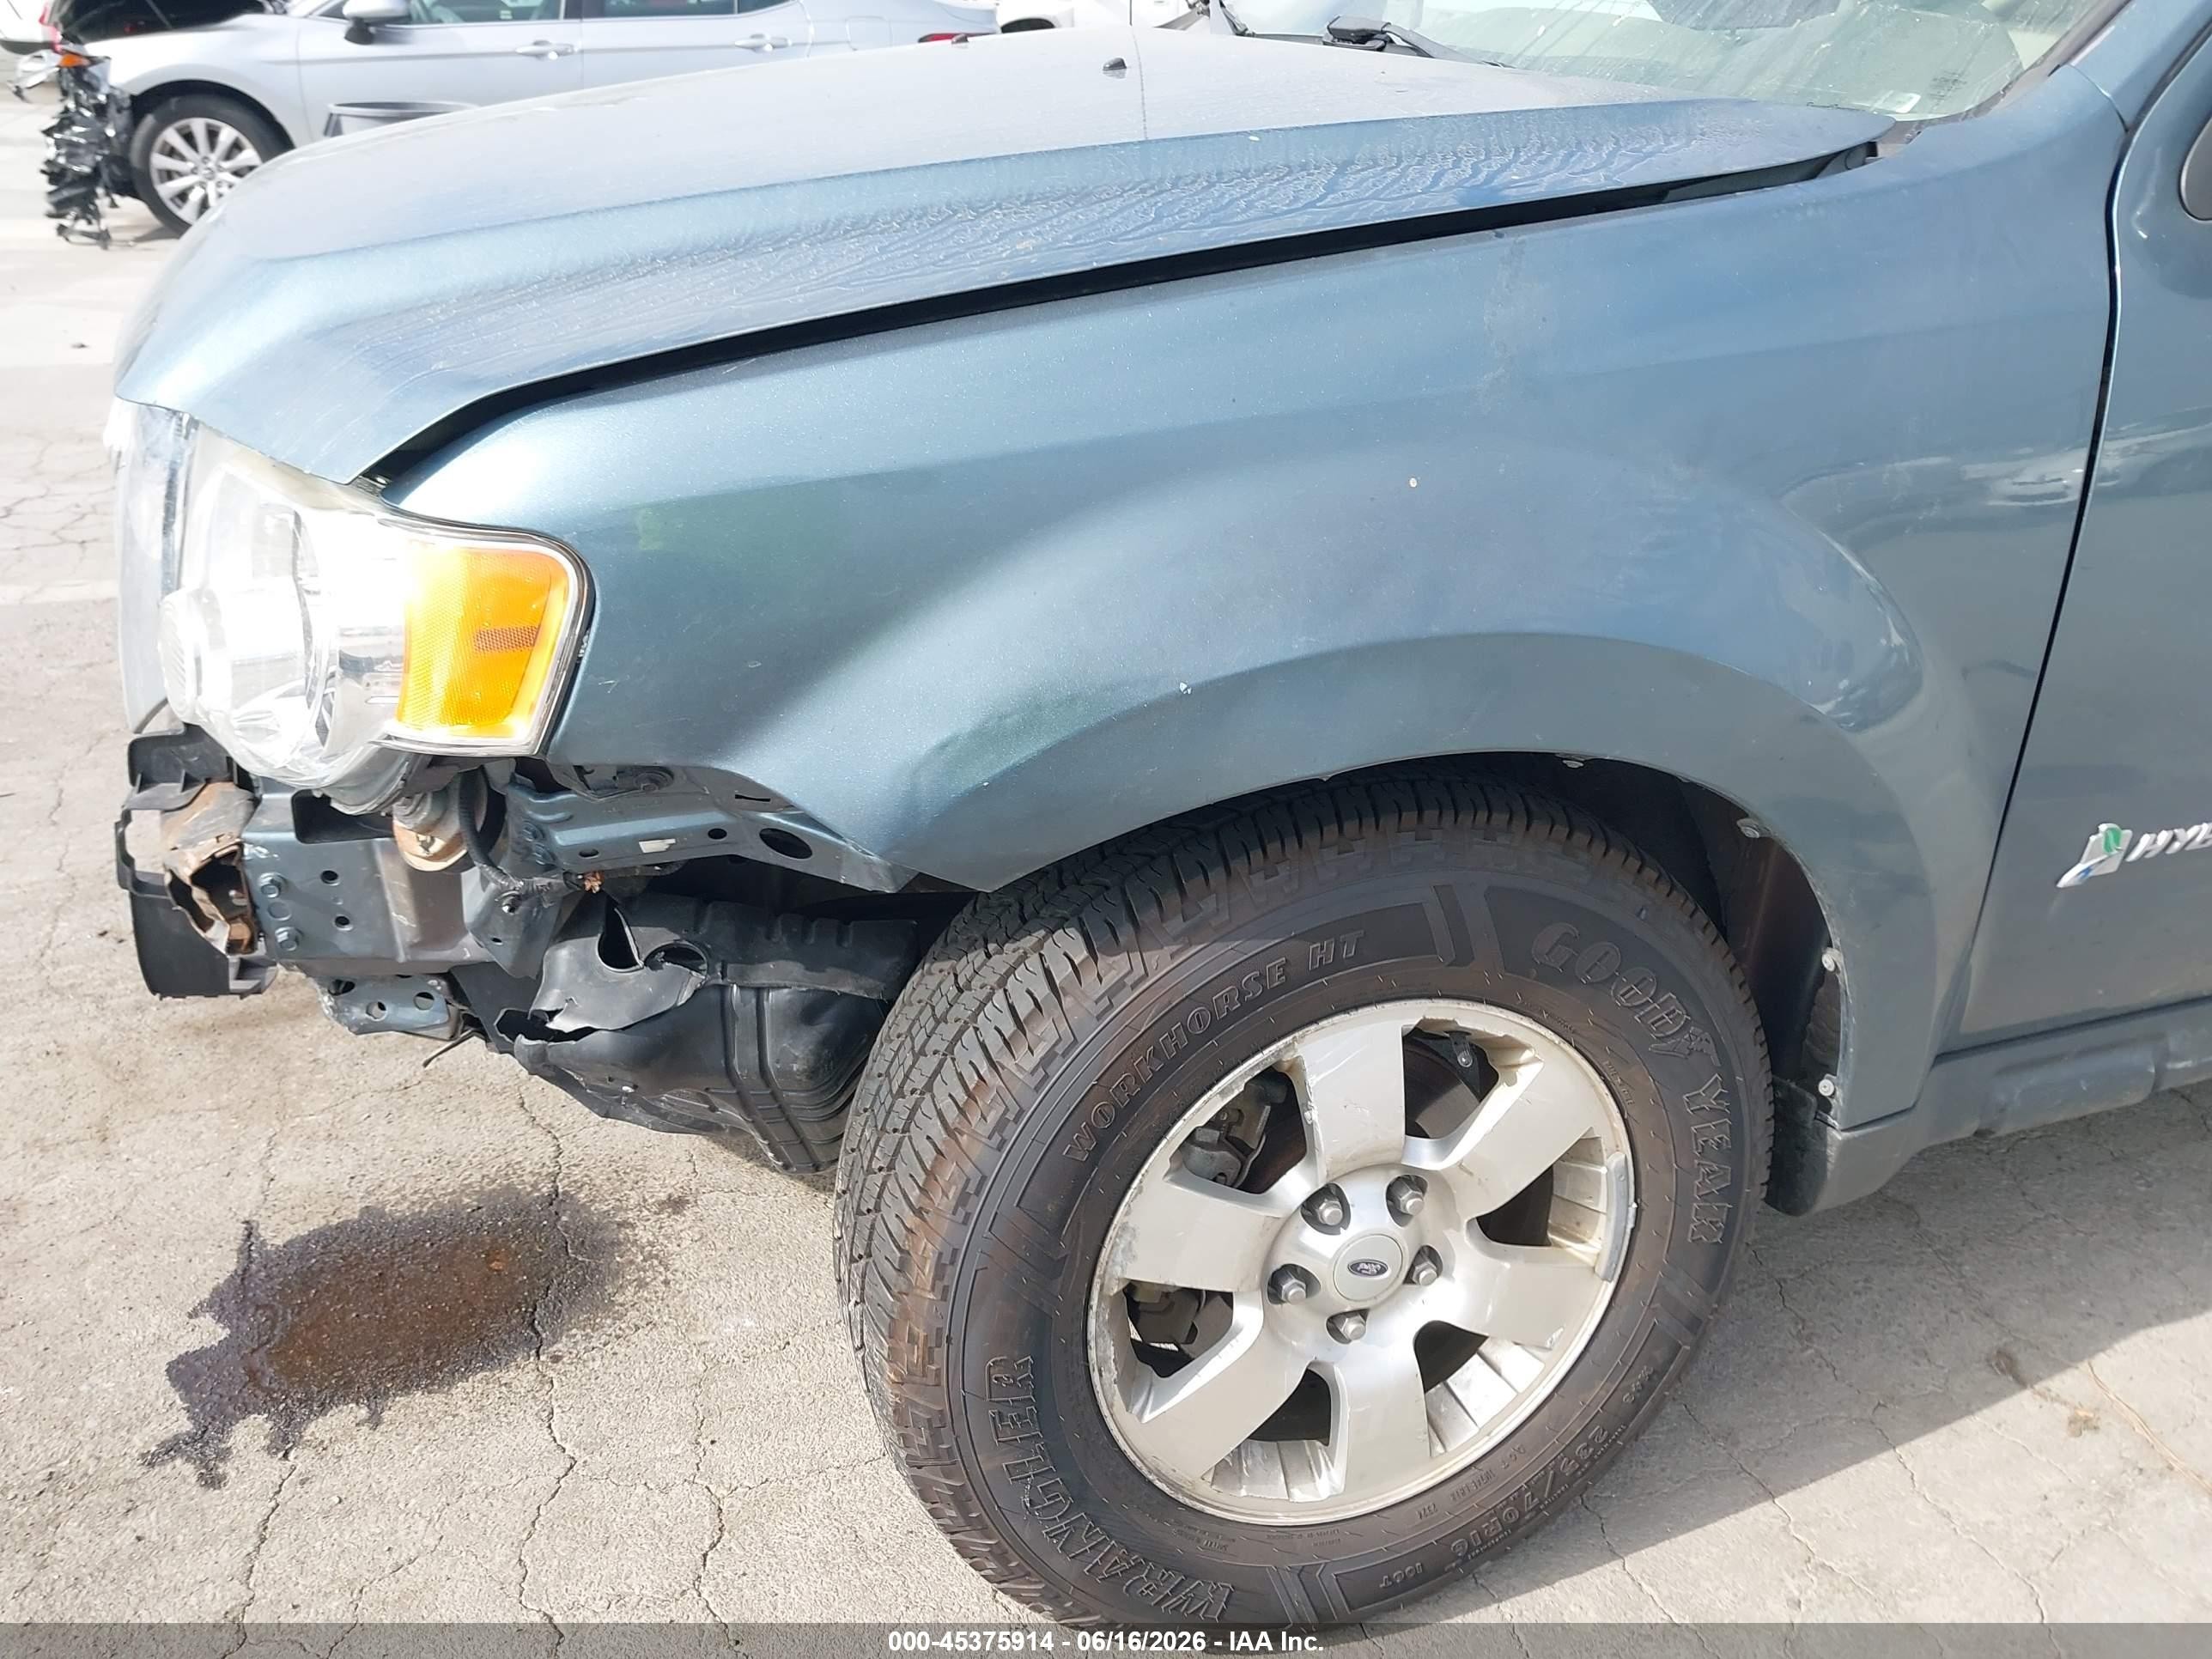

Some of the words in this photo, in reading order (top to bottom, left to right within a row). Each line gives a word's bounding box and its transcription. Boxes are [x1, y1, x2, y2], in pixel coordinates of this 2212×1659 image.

[1062, 956, 1287, 1163] WORKHORSE
[1308, 930, 1365, 971] HT
[985, 1355, 1236, 1624] WRANGLER
[1449, 1425, 1609, 1559] 235/70R16
